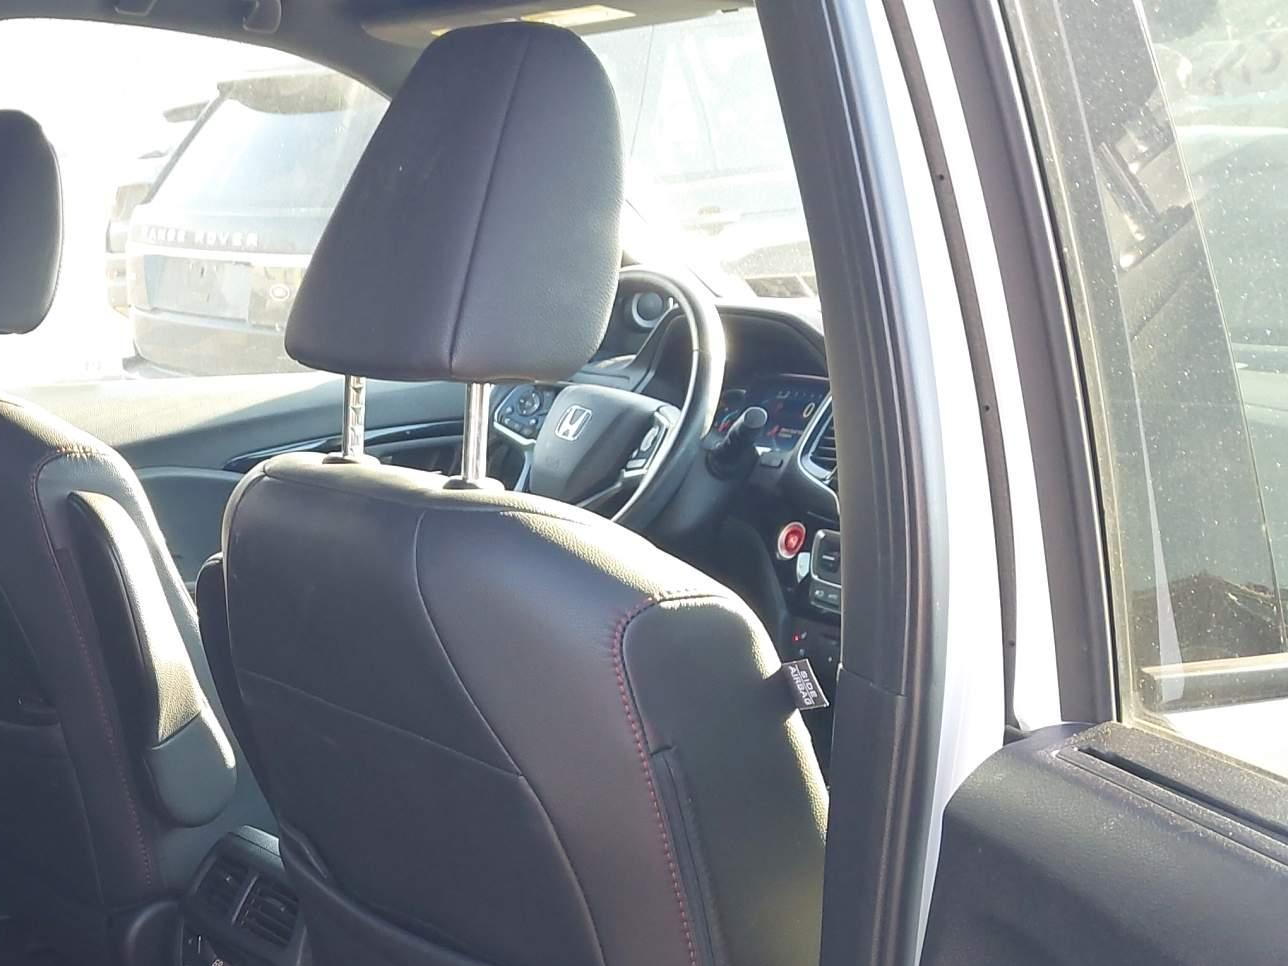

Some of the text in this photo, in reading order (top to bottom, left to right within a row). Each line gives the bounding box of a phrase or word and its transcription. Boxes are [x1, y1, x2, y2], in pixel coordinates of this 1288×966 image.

[195, 231, 259, 248] ROVER
[788, 665, 813, 706] AIRBAG
[801, 670, 818, 698] SIDE
